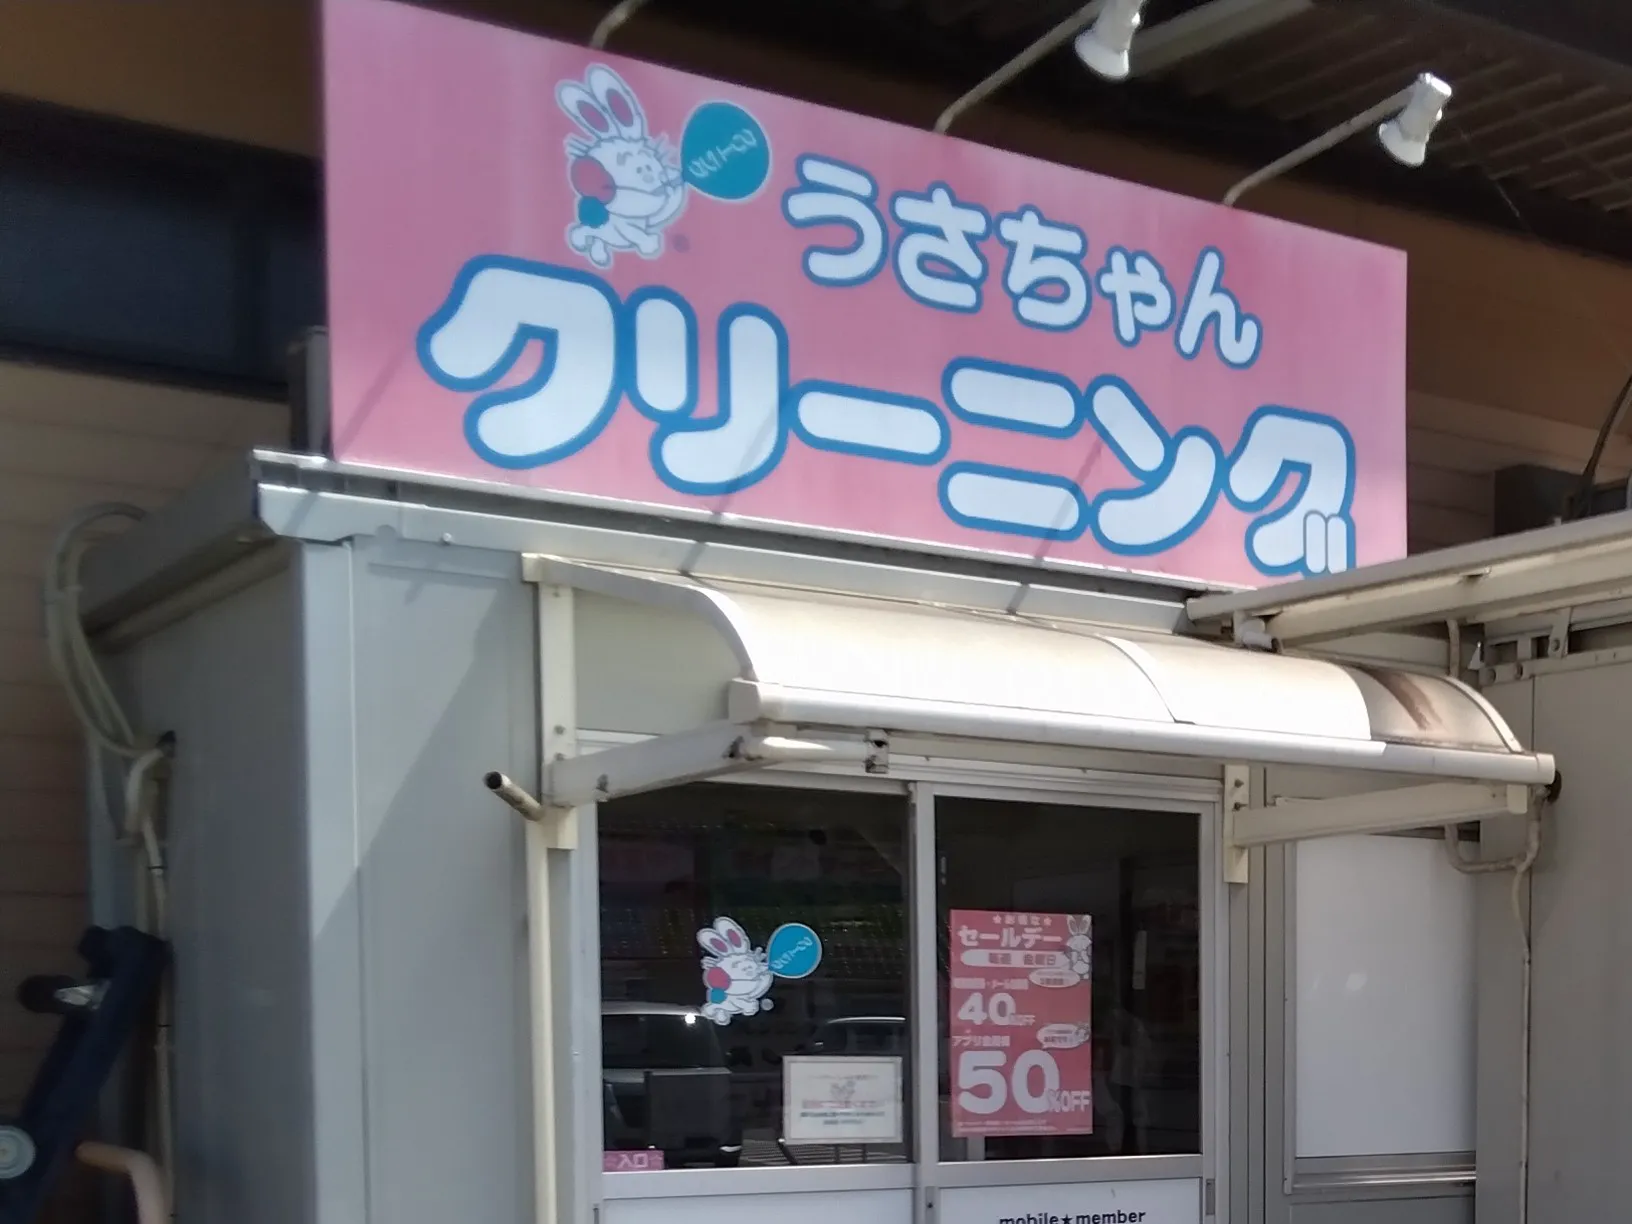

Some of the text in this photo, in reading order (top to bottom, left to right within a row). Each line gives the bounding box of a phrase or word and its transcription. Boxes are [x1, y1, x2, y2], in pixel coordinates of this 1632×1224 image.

[785, 153, 1261, 367] うさちゃん
[417, 253, 1356, 579] クリーニング
[957, 924, 1063, 949] セールデー
